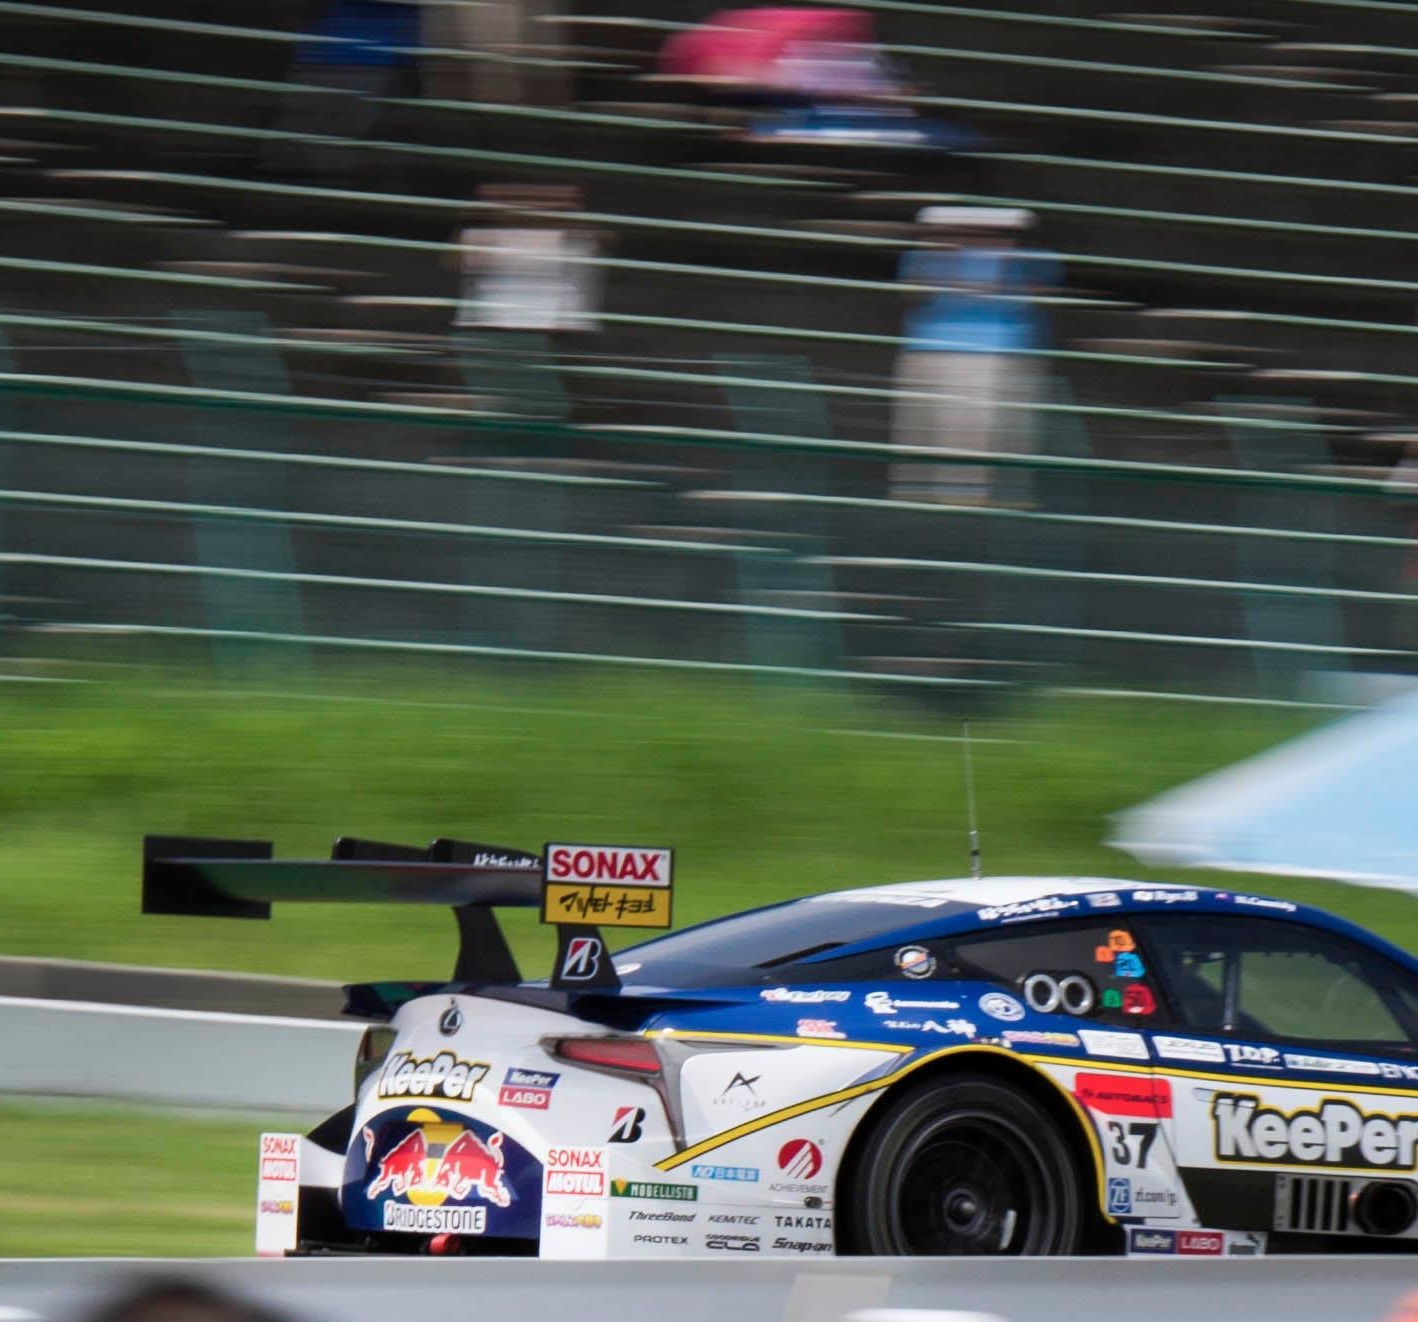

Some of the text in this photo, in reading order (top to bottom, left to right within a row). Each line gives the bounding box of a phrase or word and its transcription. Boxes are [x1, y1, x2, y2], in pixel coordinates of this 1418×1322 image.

[552, 849, 660, 881] SONAX
[381, 1052, 487, 1099] KeePer
[508, 1071, 552, 1085] KeePer
[502, 1091, 546, 1105] LABO
[1108, 1121, 1159, 1169] 37
[548, 1149, 602, 1168] SONAX
[548, 1173, 601, 1193] MOTUL
[631, 1183, 694, 1199] MODELLISTA
[386, 1202, 483, 1230] BRIDGESTONE
[629, 1210, 697, 1222] ThreeBond
[708, 1214, 760, 1225] KEMITEC
[774, 1216, 832, 1229] TAKATA
[634, 1234, 689, 1245] PROTEX
[772, 1238, 832, 1252] Snap-on
[1134, 1233, 1172, 1248] KeePer
[1182, 1236, 1220, 1250] LABO
